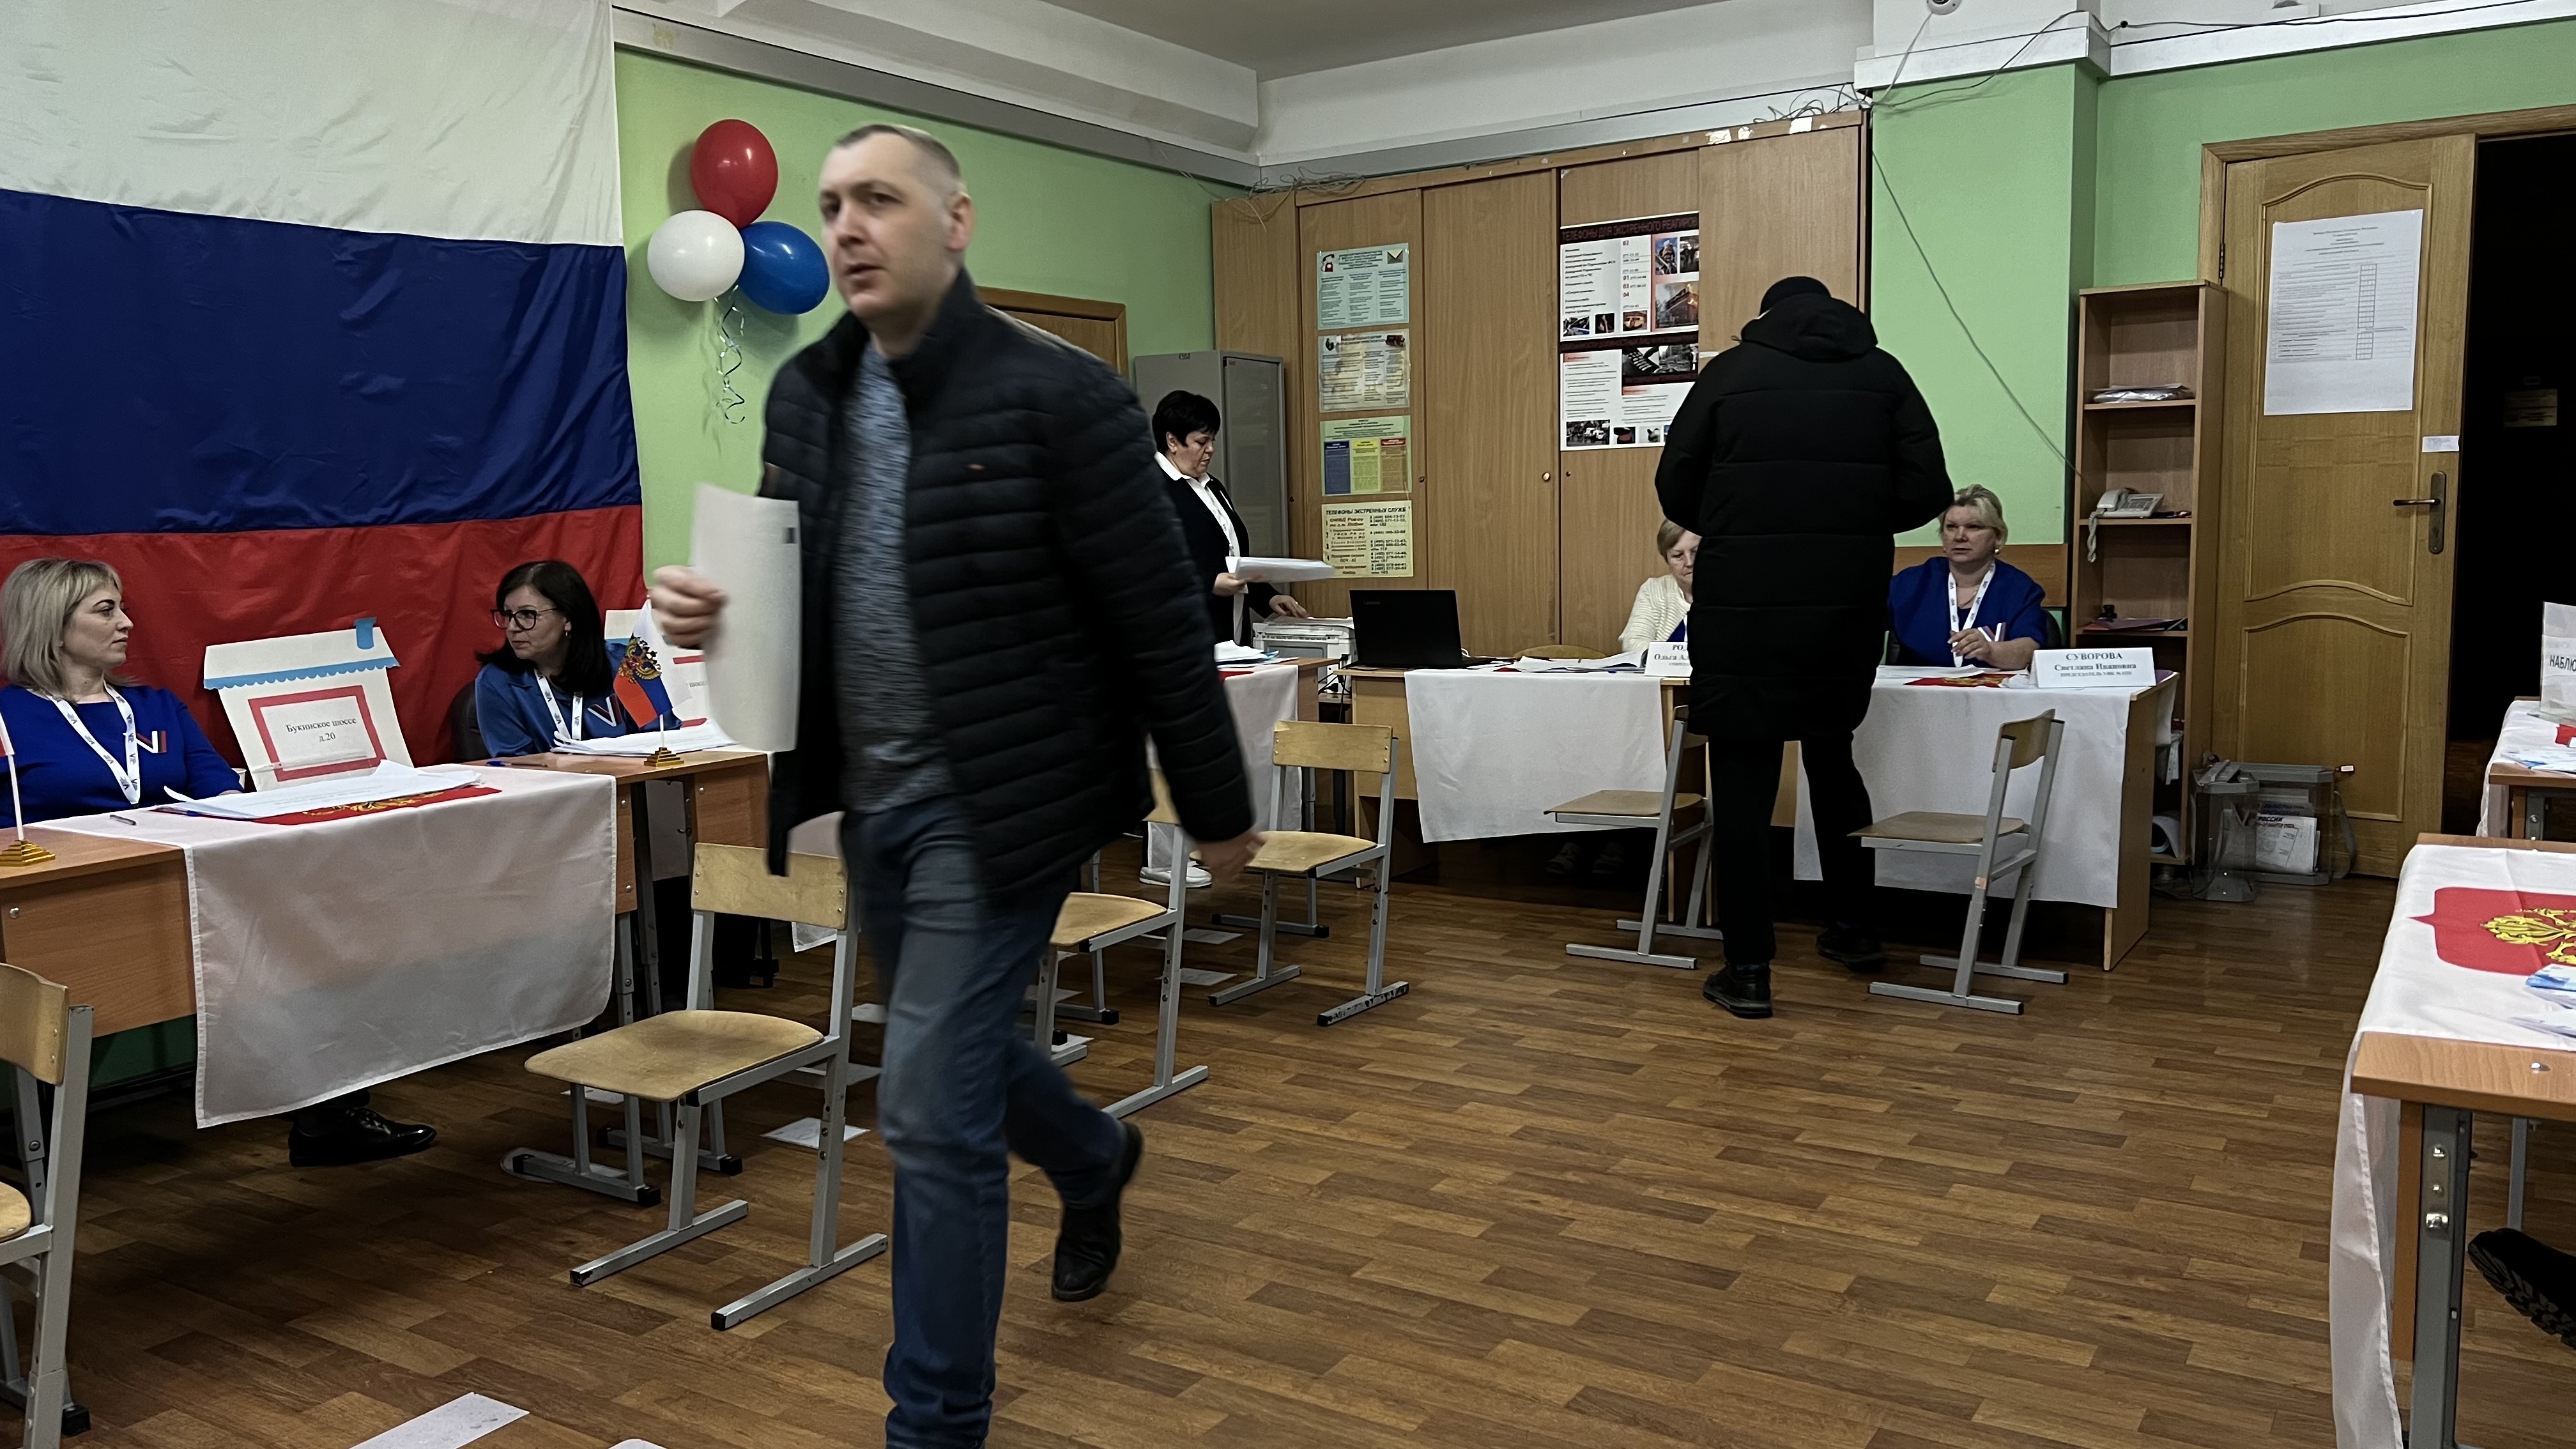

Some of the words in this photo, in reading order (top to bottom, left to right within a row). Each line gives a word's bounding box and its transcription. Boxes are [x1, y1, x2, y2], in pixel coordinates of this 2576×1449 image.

[1562, 231, 1598, 241] ТЕЛЕФОНЫ
[1598, 226, 1612, 238] ДЛЯ
[1613, 220, 1661, 236] ЭКСТРЕННОГО
[2066, 652, 2122, 661] СУВОРОВА
[2054, 663, 2094, 671] Светлана
[2549, 655, 2576, 672] НАБЛЮ
[286, 721, 330, 734] Букинское
[332, 718, 356, 726] шоссе
[319, 732, 336, 742] д.20
